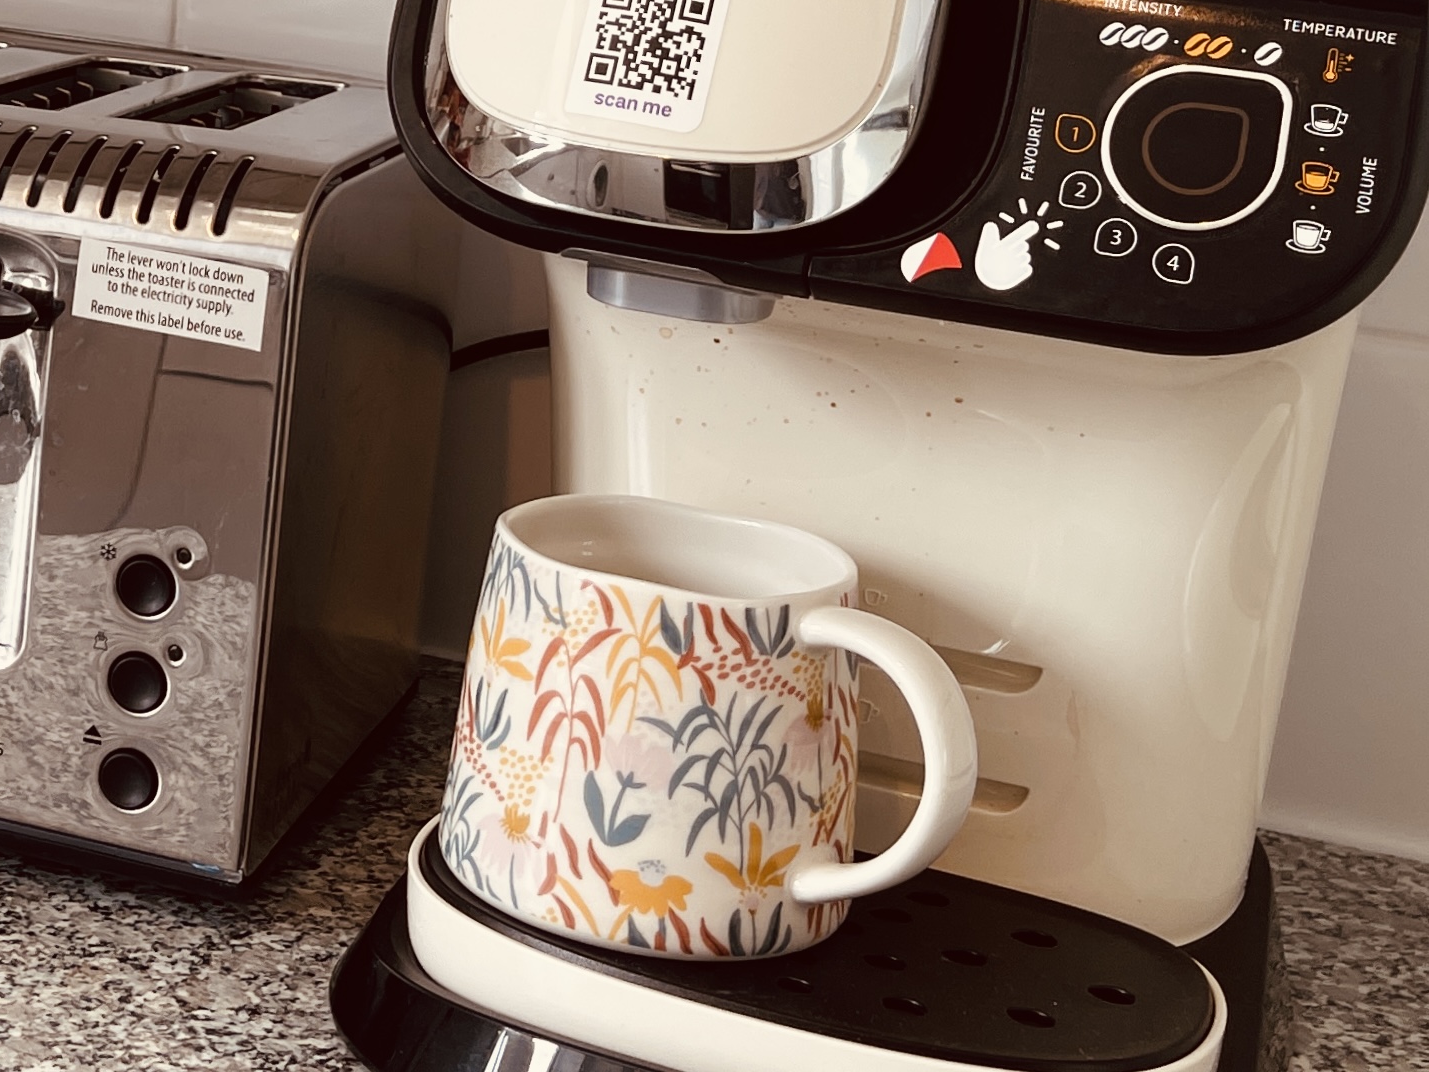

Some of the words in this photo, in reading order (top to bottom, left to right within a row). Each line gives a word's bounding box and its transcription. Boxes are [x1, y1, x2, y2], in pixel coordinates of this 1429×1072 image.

[1283, 18, 1399, 46] TEMPERATURE
[594, 93, 638, 112] scan
[642, 101, 673, 118] me
[1021, 106, 1046, 182] FAVOURITE
[1071, 126, 1080, 143] 1
[1074, 182, 1087, 199] 2
[1356, 156, 1378, 215] VOLUME
[1110, 229, 1123, 246] 3
[106, 246, 125, 263] The
[127, 250, 154, 268] lever
[156, 259, 186, 275] won't
[189, 261, 211, 279] lock
[213, 266, 244, 285] down
[1166, 255, 1180, 271] 4
[91, 262, 125, 278] unless
[127, 267, 145, 282] the
[148, 272, 186, 289] toaster
[187, 278, 196, 291] is
[198, 282, 255, 303] connected
[107, 280, 118, 292] to
[121, 281, 139, 297] the
[141, 285, 194, 310] electricity
[196, 297, 234, 317] supply.
[91, 299, 134, 321] Remove
[135, 308, 156, 324] this
[157, 313, 185, 329] label
[187, 317, 221, 337] before
[224, 327, 246, 342] use.
